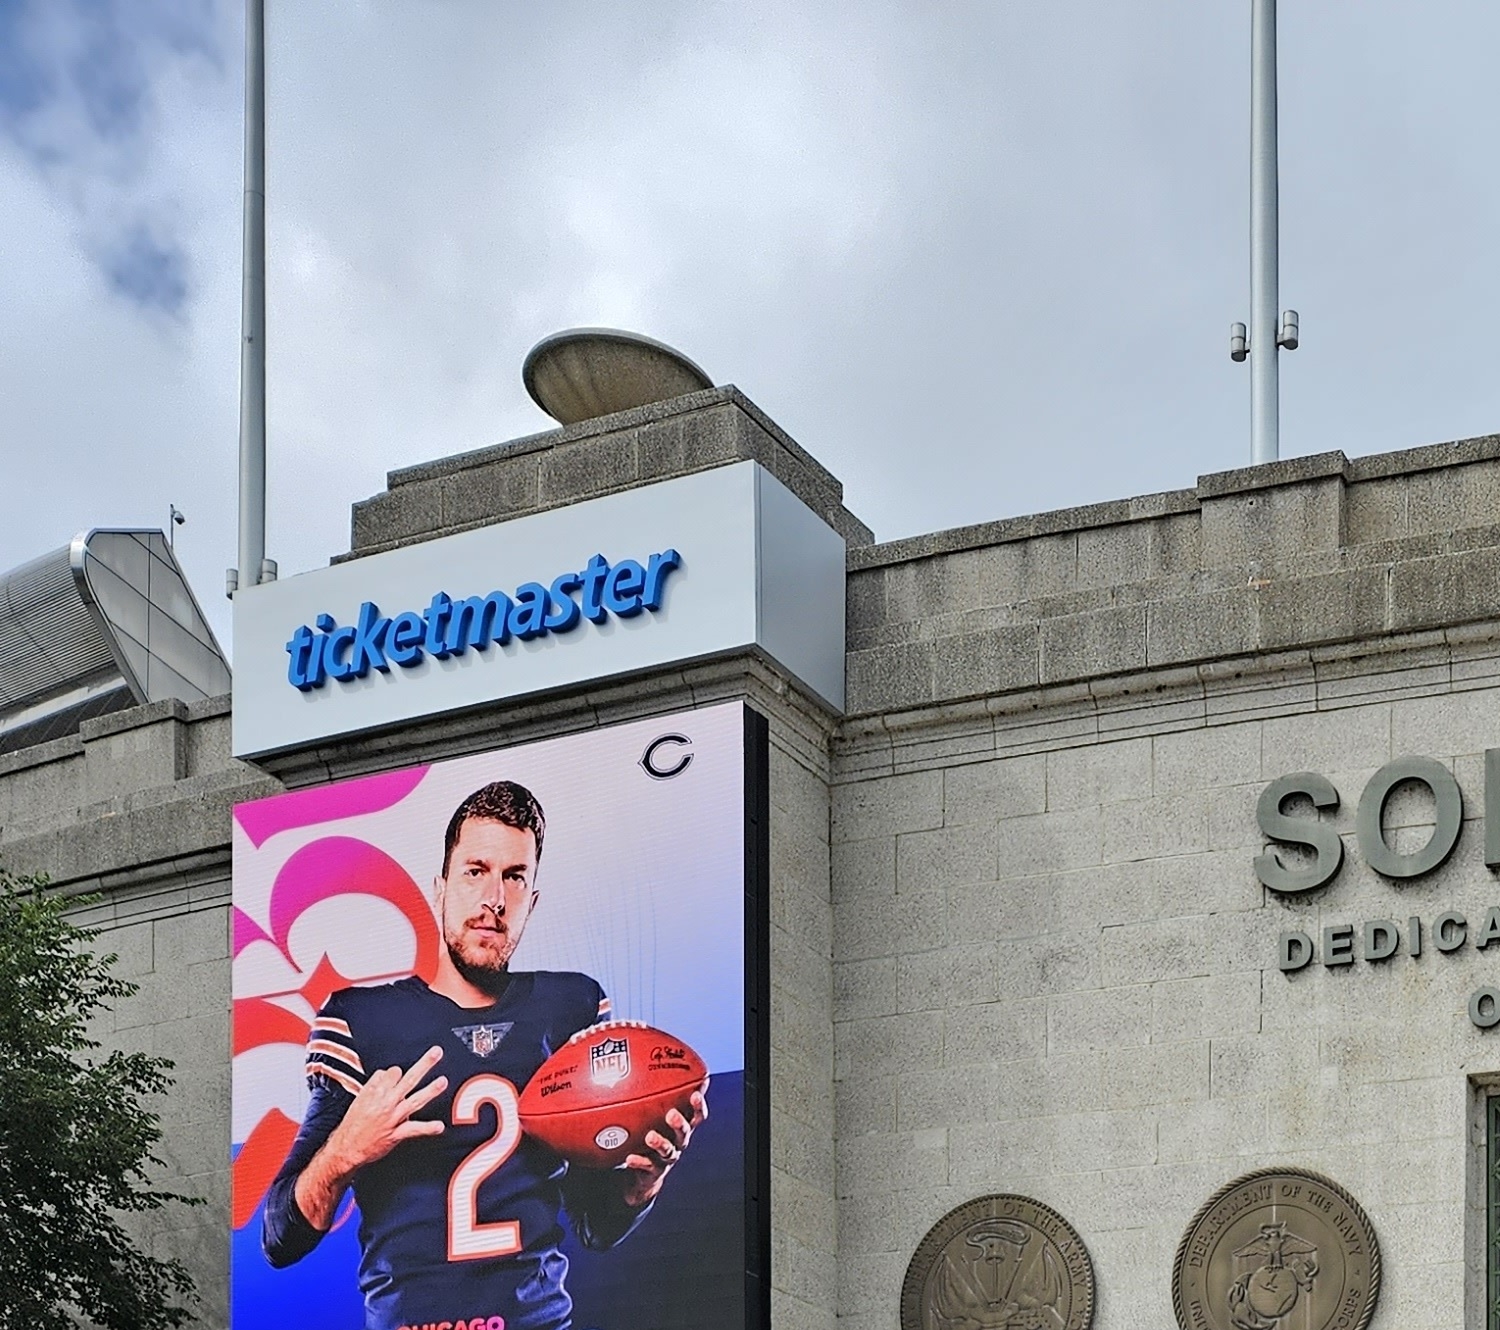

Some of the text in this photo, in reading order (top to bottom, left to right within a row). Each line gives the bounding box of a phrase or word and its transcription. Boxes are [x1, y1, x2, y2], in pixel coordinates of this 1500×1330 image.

[286, 549, 681, 691] ticketmaster
[595, 1054, 626, 1072] NFL
[447, 1073, 522, 1262] 2
[1004, 1201, 1026, 1216] OF
[1033, 1209, 1063, 1238] THE
[1059, 1240, 1088, 1288] ARMY
[1189, 1184, 1364, 1269] DEPARTMENT OF THE NAVY
